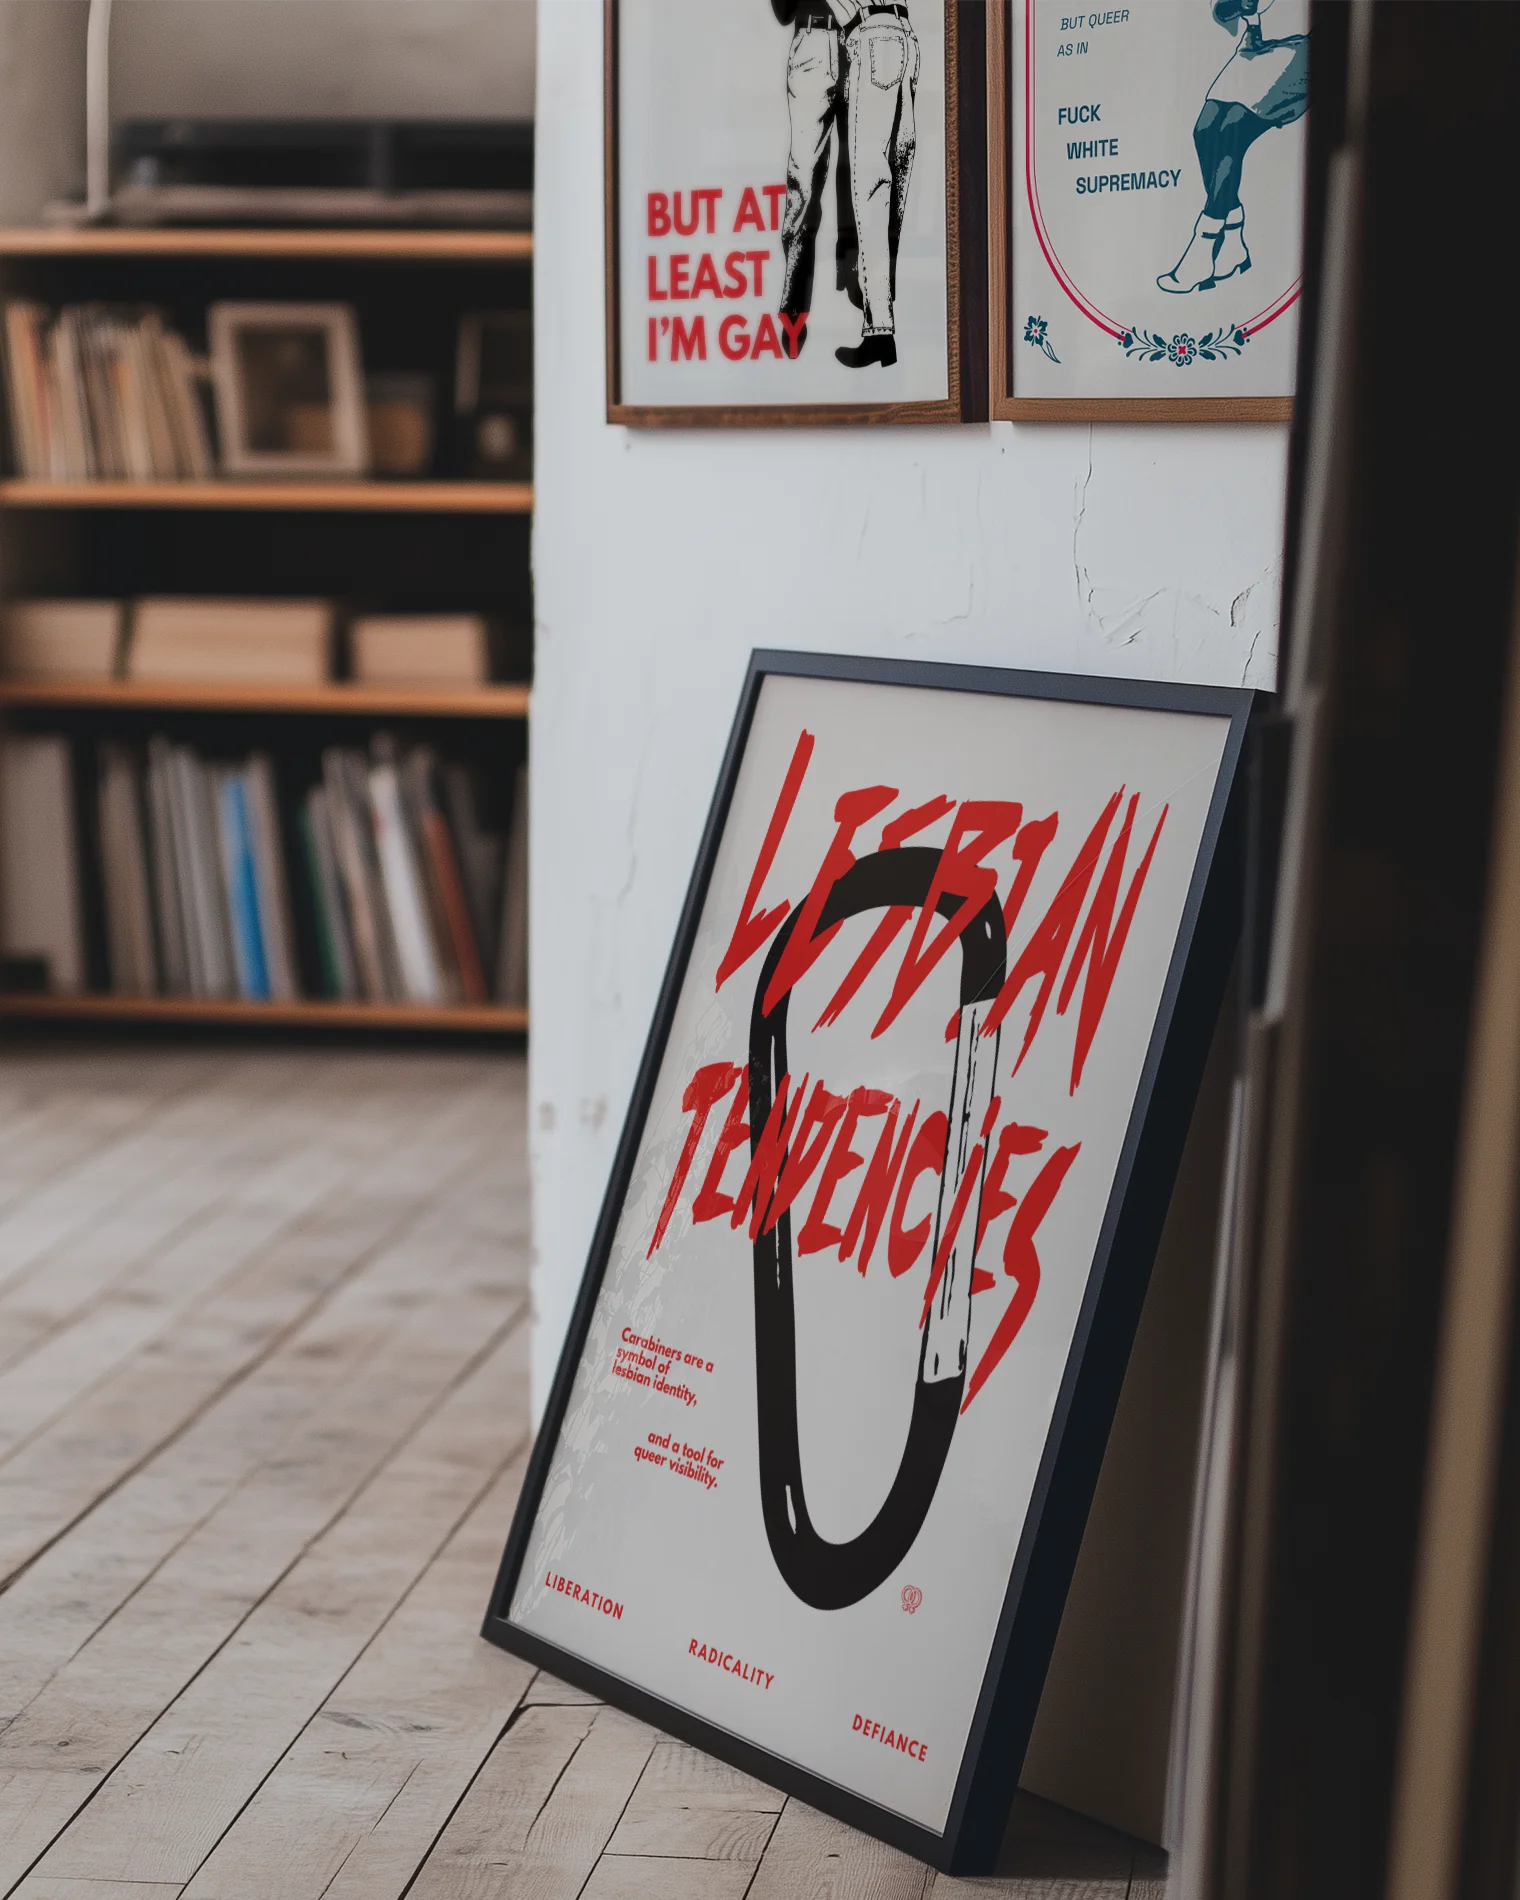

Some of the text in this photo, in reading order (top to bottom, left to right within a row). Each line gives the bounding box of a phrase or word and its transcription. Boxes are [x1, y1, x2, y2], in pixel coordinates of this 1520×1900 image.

[1060, 9, 1130, 31] BUT QUEER
[1057, 41, 1089, 57] AS IN
[1058, 104, 1101, 125] FUCK
[1067, 138, 1119, 160] WHITE
[1076, 169, 1182, 194] SUPREMACY
[647, 184, 787, 237] BUT AT
[647, 250, 770, 301] LEAST
[647, 312, 810, 362] I'M GAY
[715, 728, 1169, 1096] LESBIAN
[647, 1062, 1082, 1415] TENDENCIES
[616, 1347, 672, 1375] symbol of
[621, 1327, 714, 1373] Carabiners are a
[611, 1359, 697, 1407] lesbian identity,
[634, 1445, 718, 1490] queer visibility.
[648, 1432, 724, 1470] and a tool for
[545, 1571, 624, 1620] LIBERATION
[689, 1638, 775, 1690] RADICALITY
[852, 1714, 928, 1762] DEFIANCE
